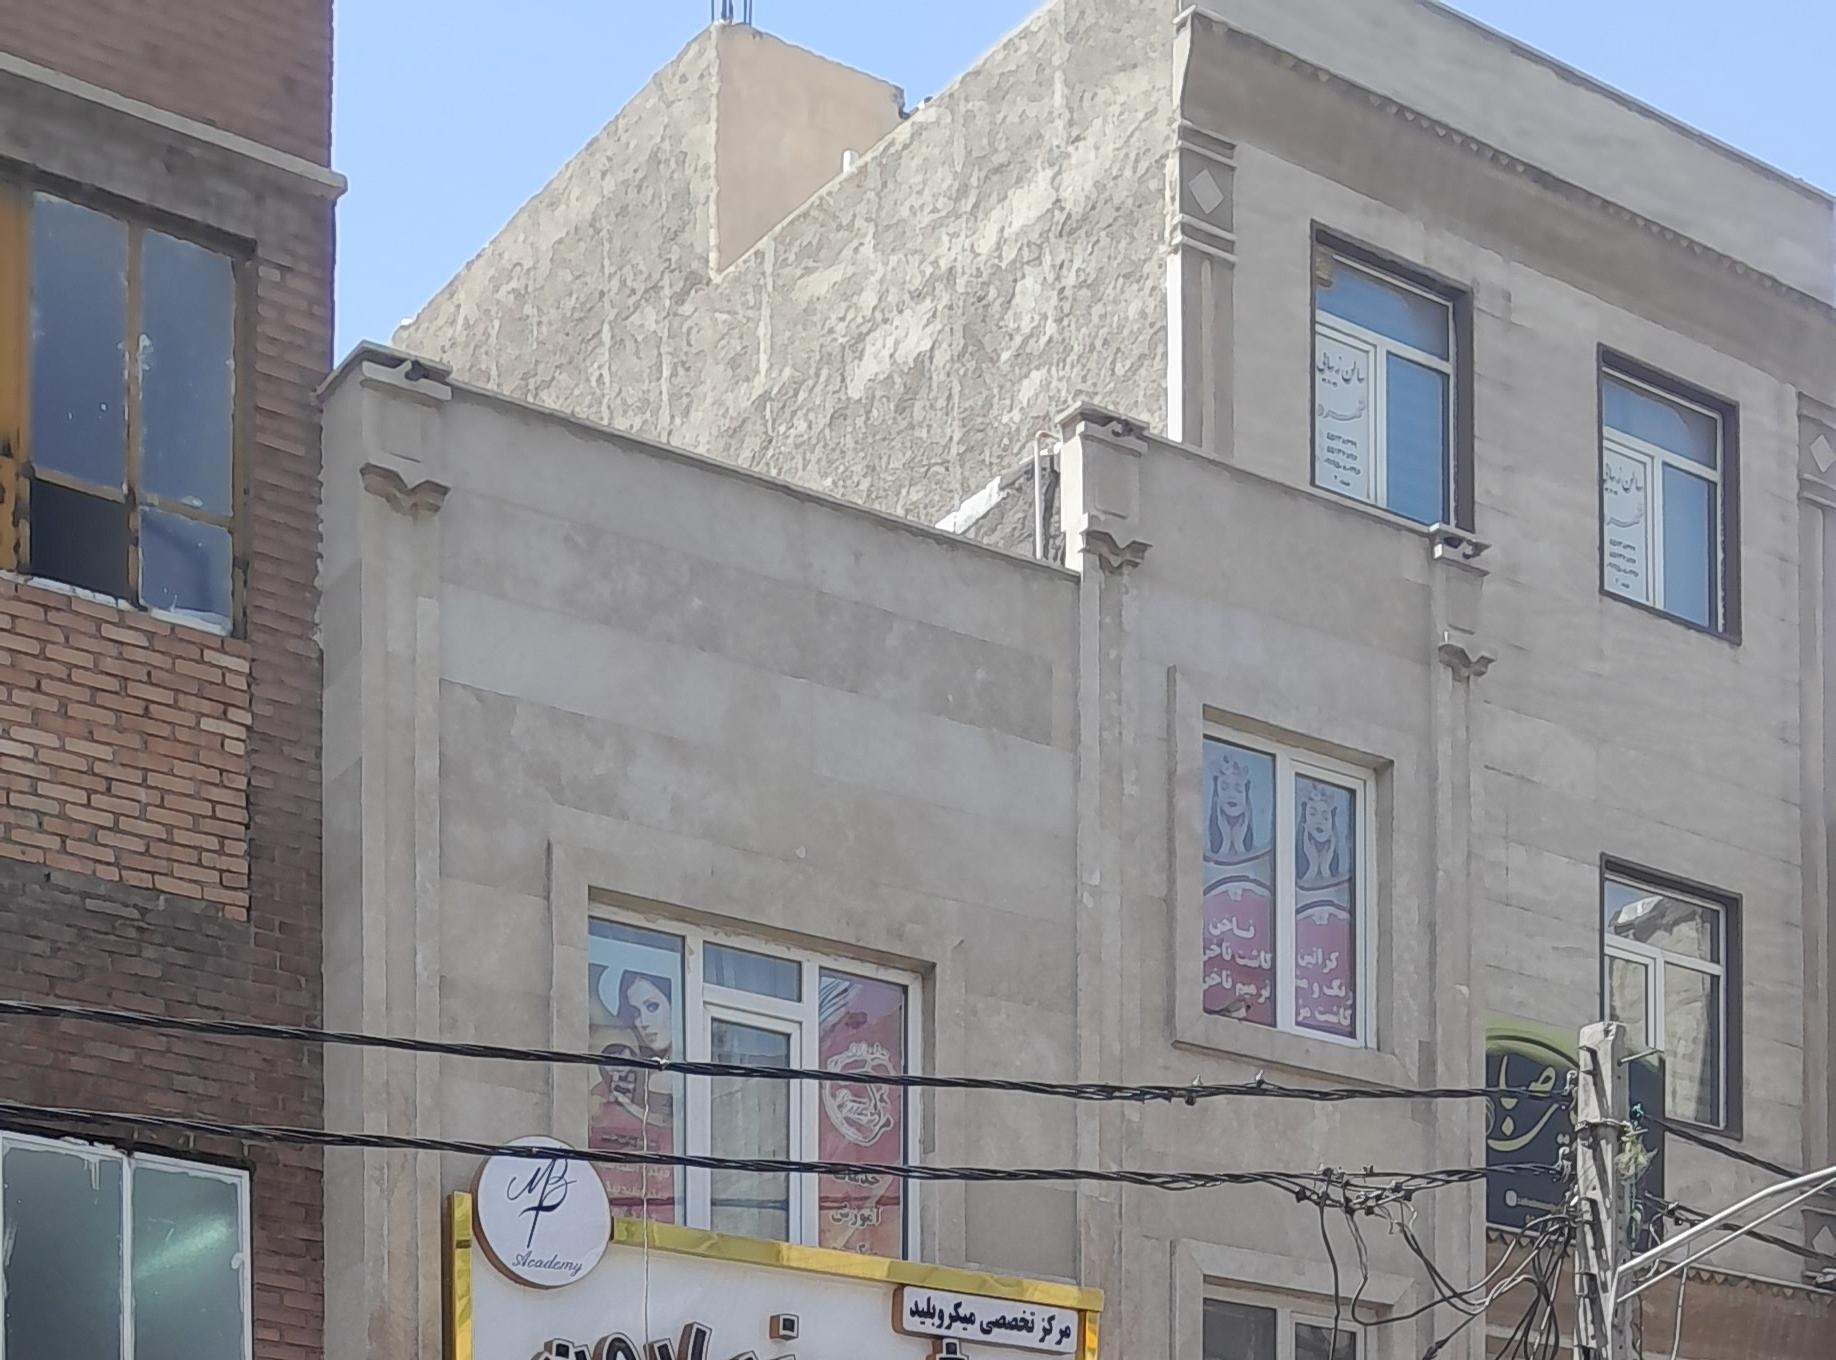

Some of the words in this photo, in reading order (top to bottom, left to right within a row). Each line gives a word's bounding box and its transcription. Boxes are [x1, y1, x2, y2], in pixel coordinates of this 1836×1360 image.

[1208, 916, 1255, 938] ناخن
[1235, 950, 1272, 969] کاشت
[1236, 980, 1271, 1003] ترمیم
[1312, 982, 1320, 998] و
[1315, 1004, 1352, 1026] کاشت
[512, 1250, 582, 1277] Academy
[909, 1296, 976, 1331] میکروبلید
[979, 1309, 1035, 1335] تخصصی
[1038, 1313, 1072, 1345] مرکز
